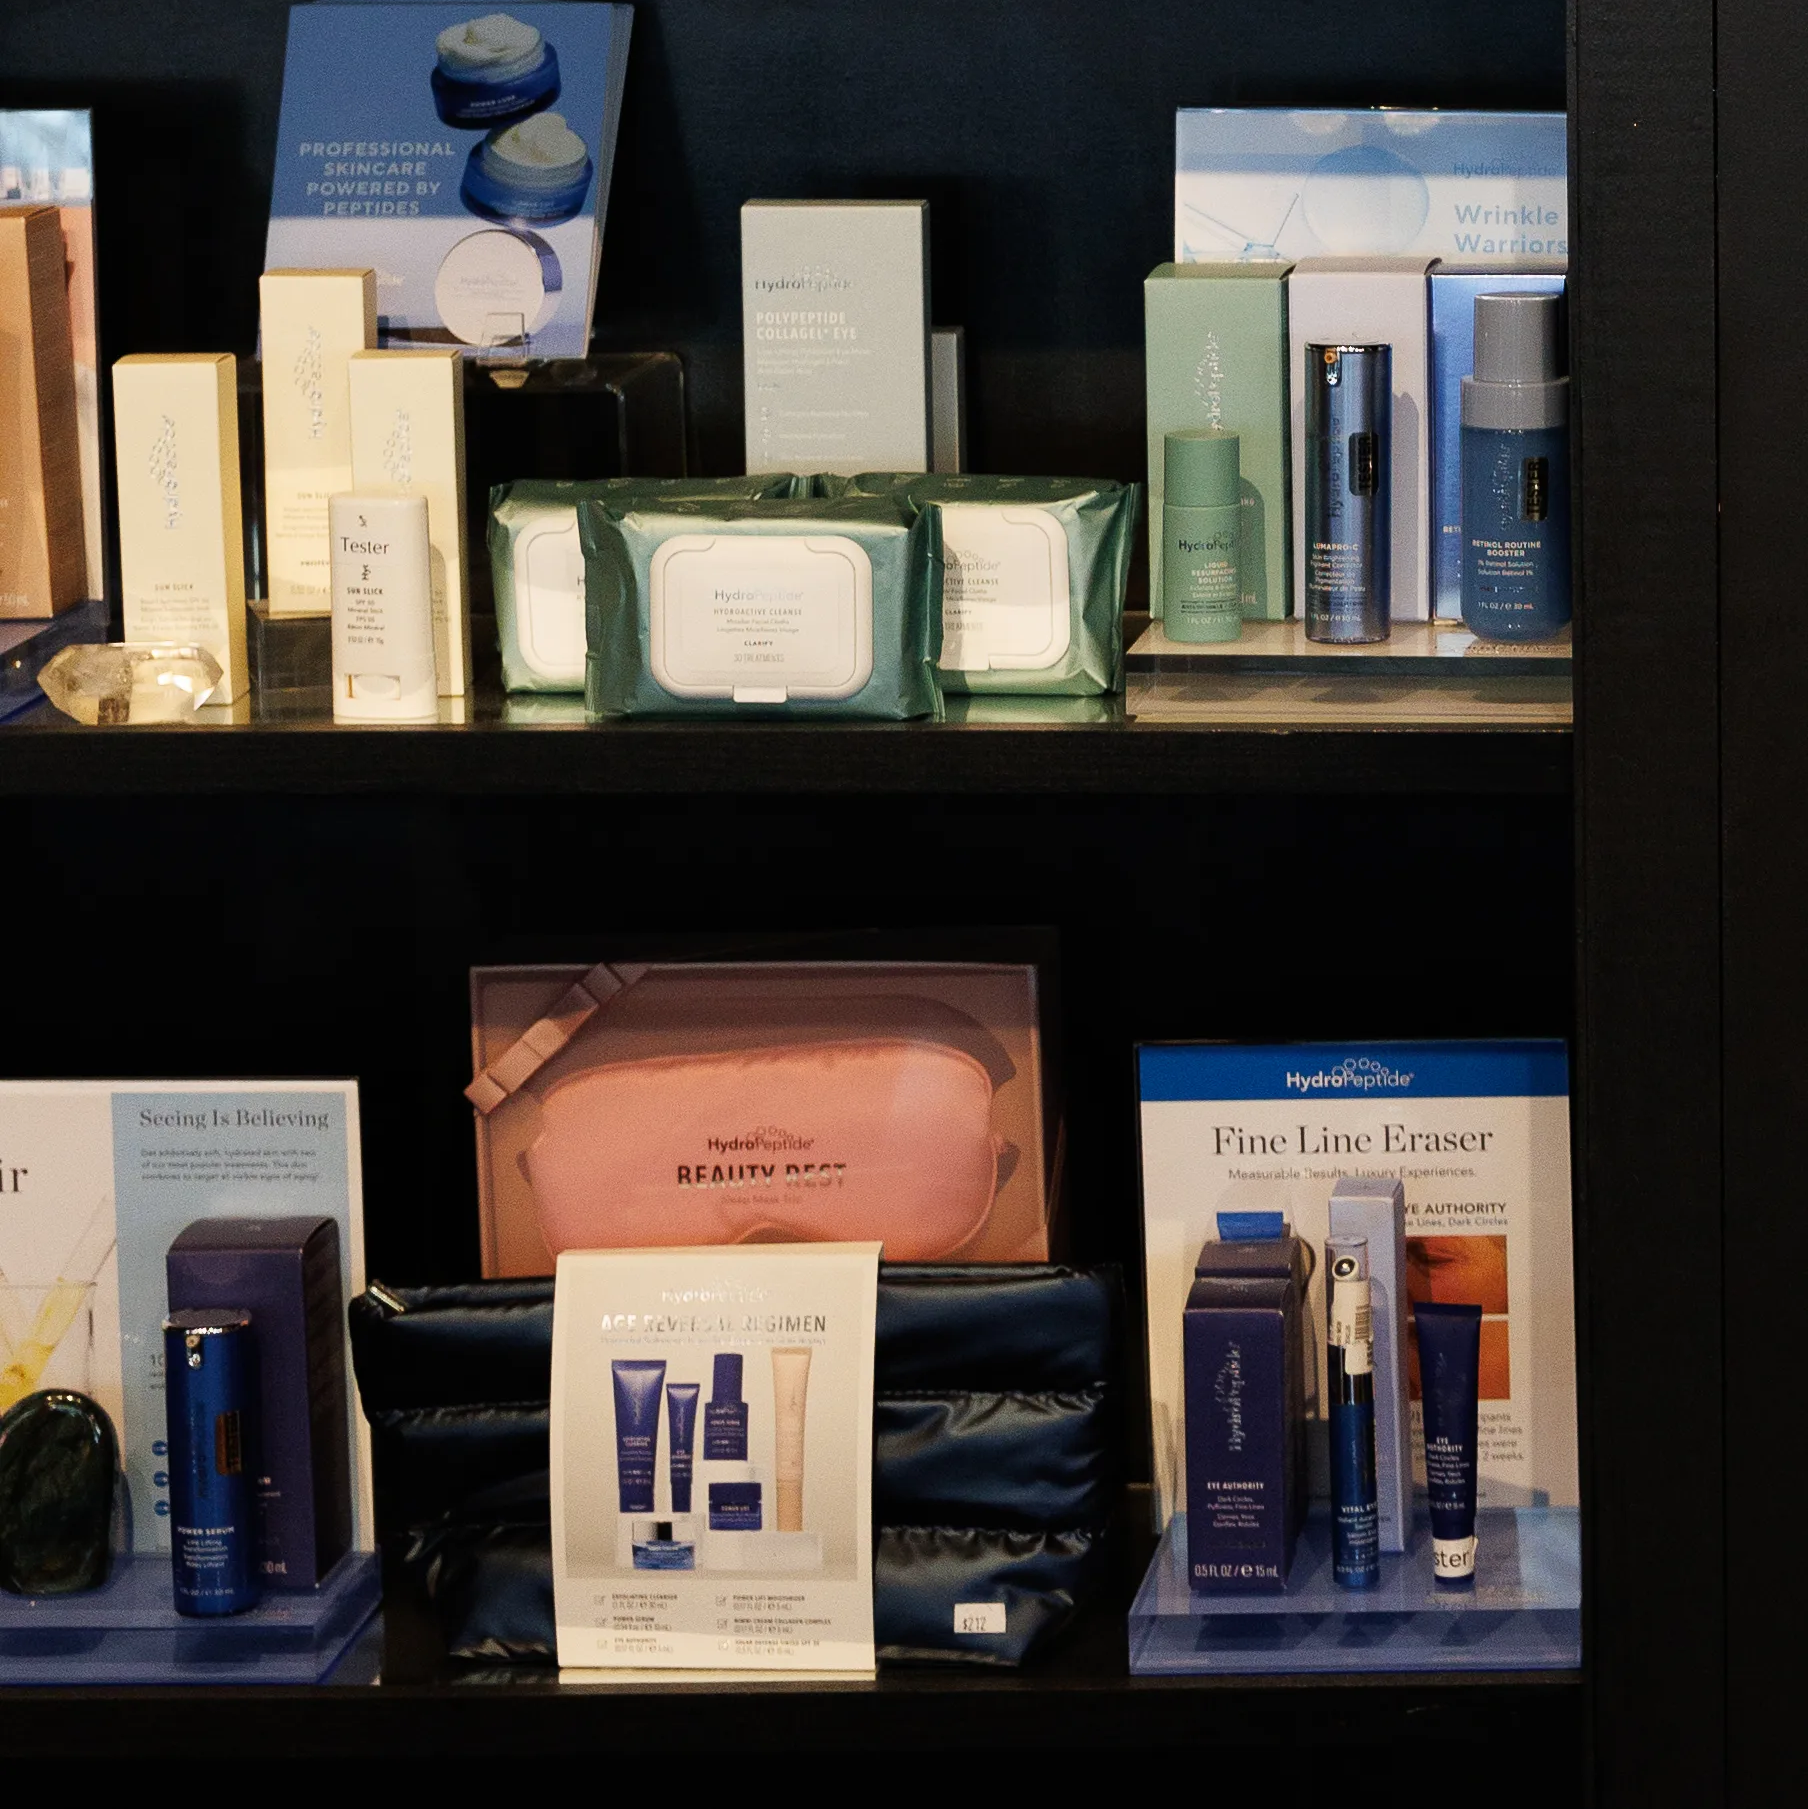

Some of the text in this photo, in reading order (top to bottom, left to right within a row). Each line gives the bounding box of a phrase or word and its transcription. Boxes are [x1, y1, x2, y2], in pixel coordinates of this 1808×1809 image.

[299, 141, 455, 158] PROFESSIONAL
[323, 161, 427, 176] SKINCARE
[306, 181, 442, 196] POWERED BY
[323, 201, 420, 216] PEPTIDES
[1454, 204, 1559, 225] Wrinkle
[1453, 233, 1568, 254] Warriors
[756, 311, 846, 325] POLYPEPTIDE
[833, 327, 857, 340] EYE
[340, 536, 390, 555] Tester
[1487, 549, 1525, 557] BOOSTER
[347, 587, 384, 595] SUN SLICK
[1286, 1071, 1411, 1092] HydroPeptide
[140, 1108, 330, 1131] Seeing Is Believing
[708, 1137, 812, 1156] HydroPeptide
[1213, 1123, 1495, 1155] Fine Line Eraser
[677, 1163, 848, 1189] BEAUTY REST
[1228, 1168, 1301, 1180] Measurable
[1425, 1202, 1508, 1215] AUTHORITY
[1448, 1216, 1509, 1227] Dark Circles
[601, 1314, 637, 1331] AGE
[742, 1314, 827, 1332] REGIMEN
[1207, 1481, 1264, 1490] EYE AUTHORITY
[962, 1618, 987, 1632] $212
